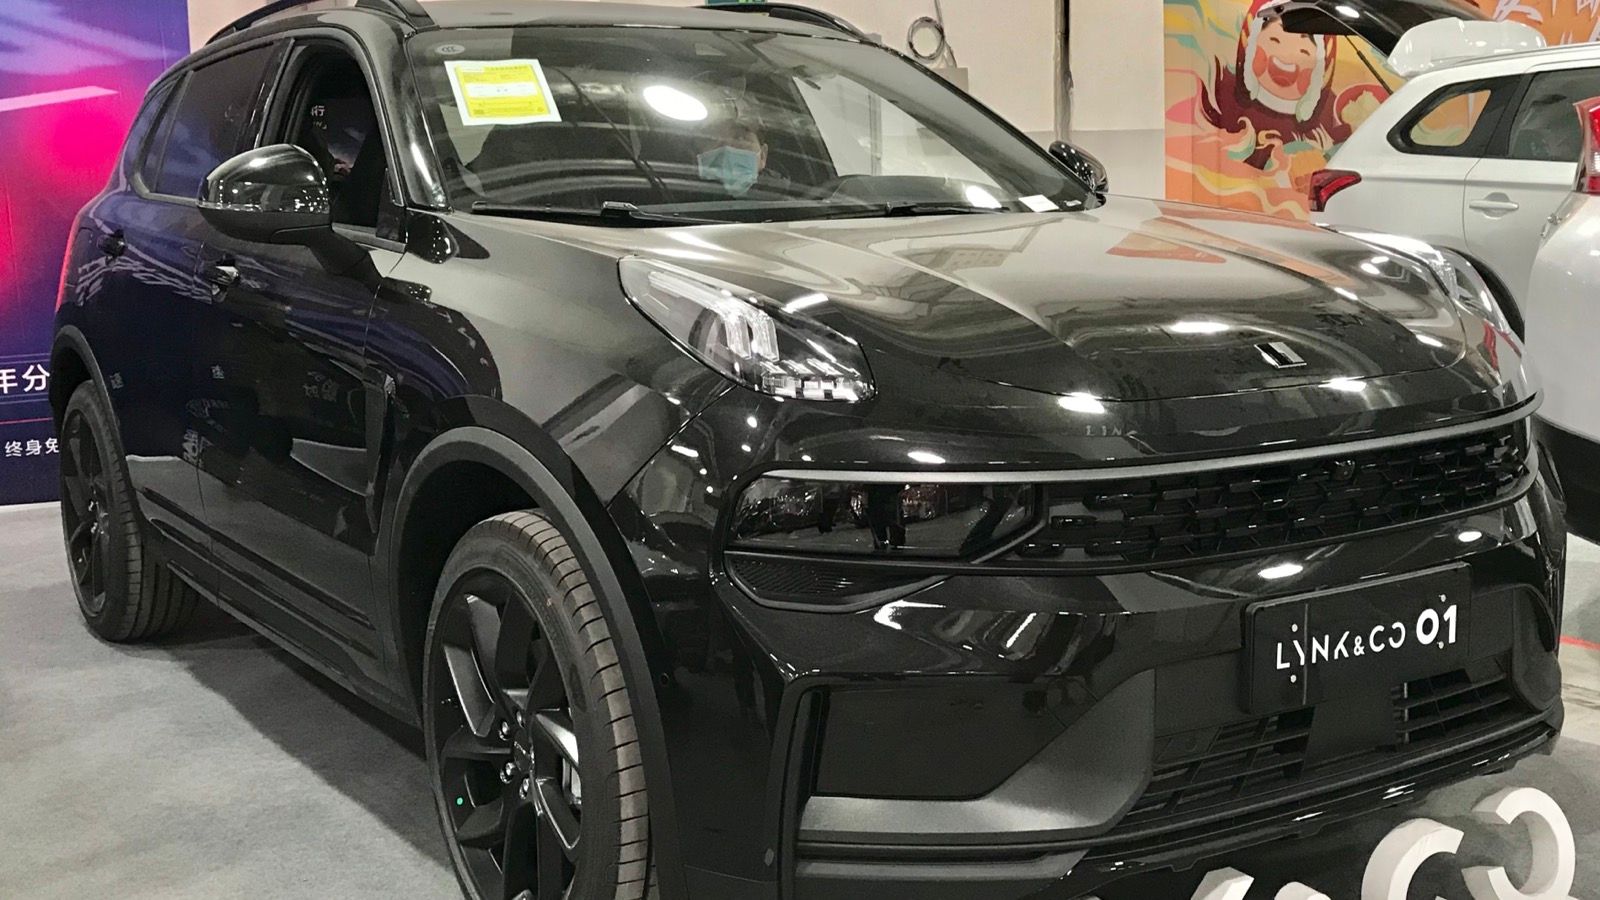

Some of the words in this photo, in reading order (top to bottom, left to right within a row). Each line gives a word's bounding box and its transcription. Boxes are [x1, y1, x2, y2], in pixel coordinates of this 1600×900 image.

[5, 437, 60, 457] 终身免
[1415, 604, 1457, 645] 01
